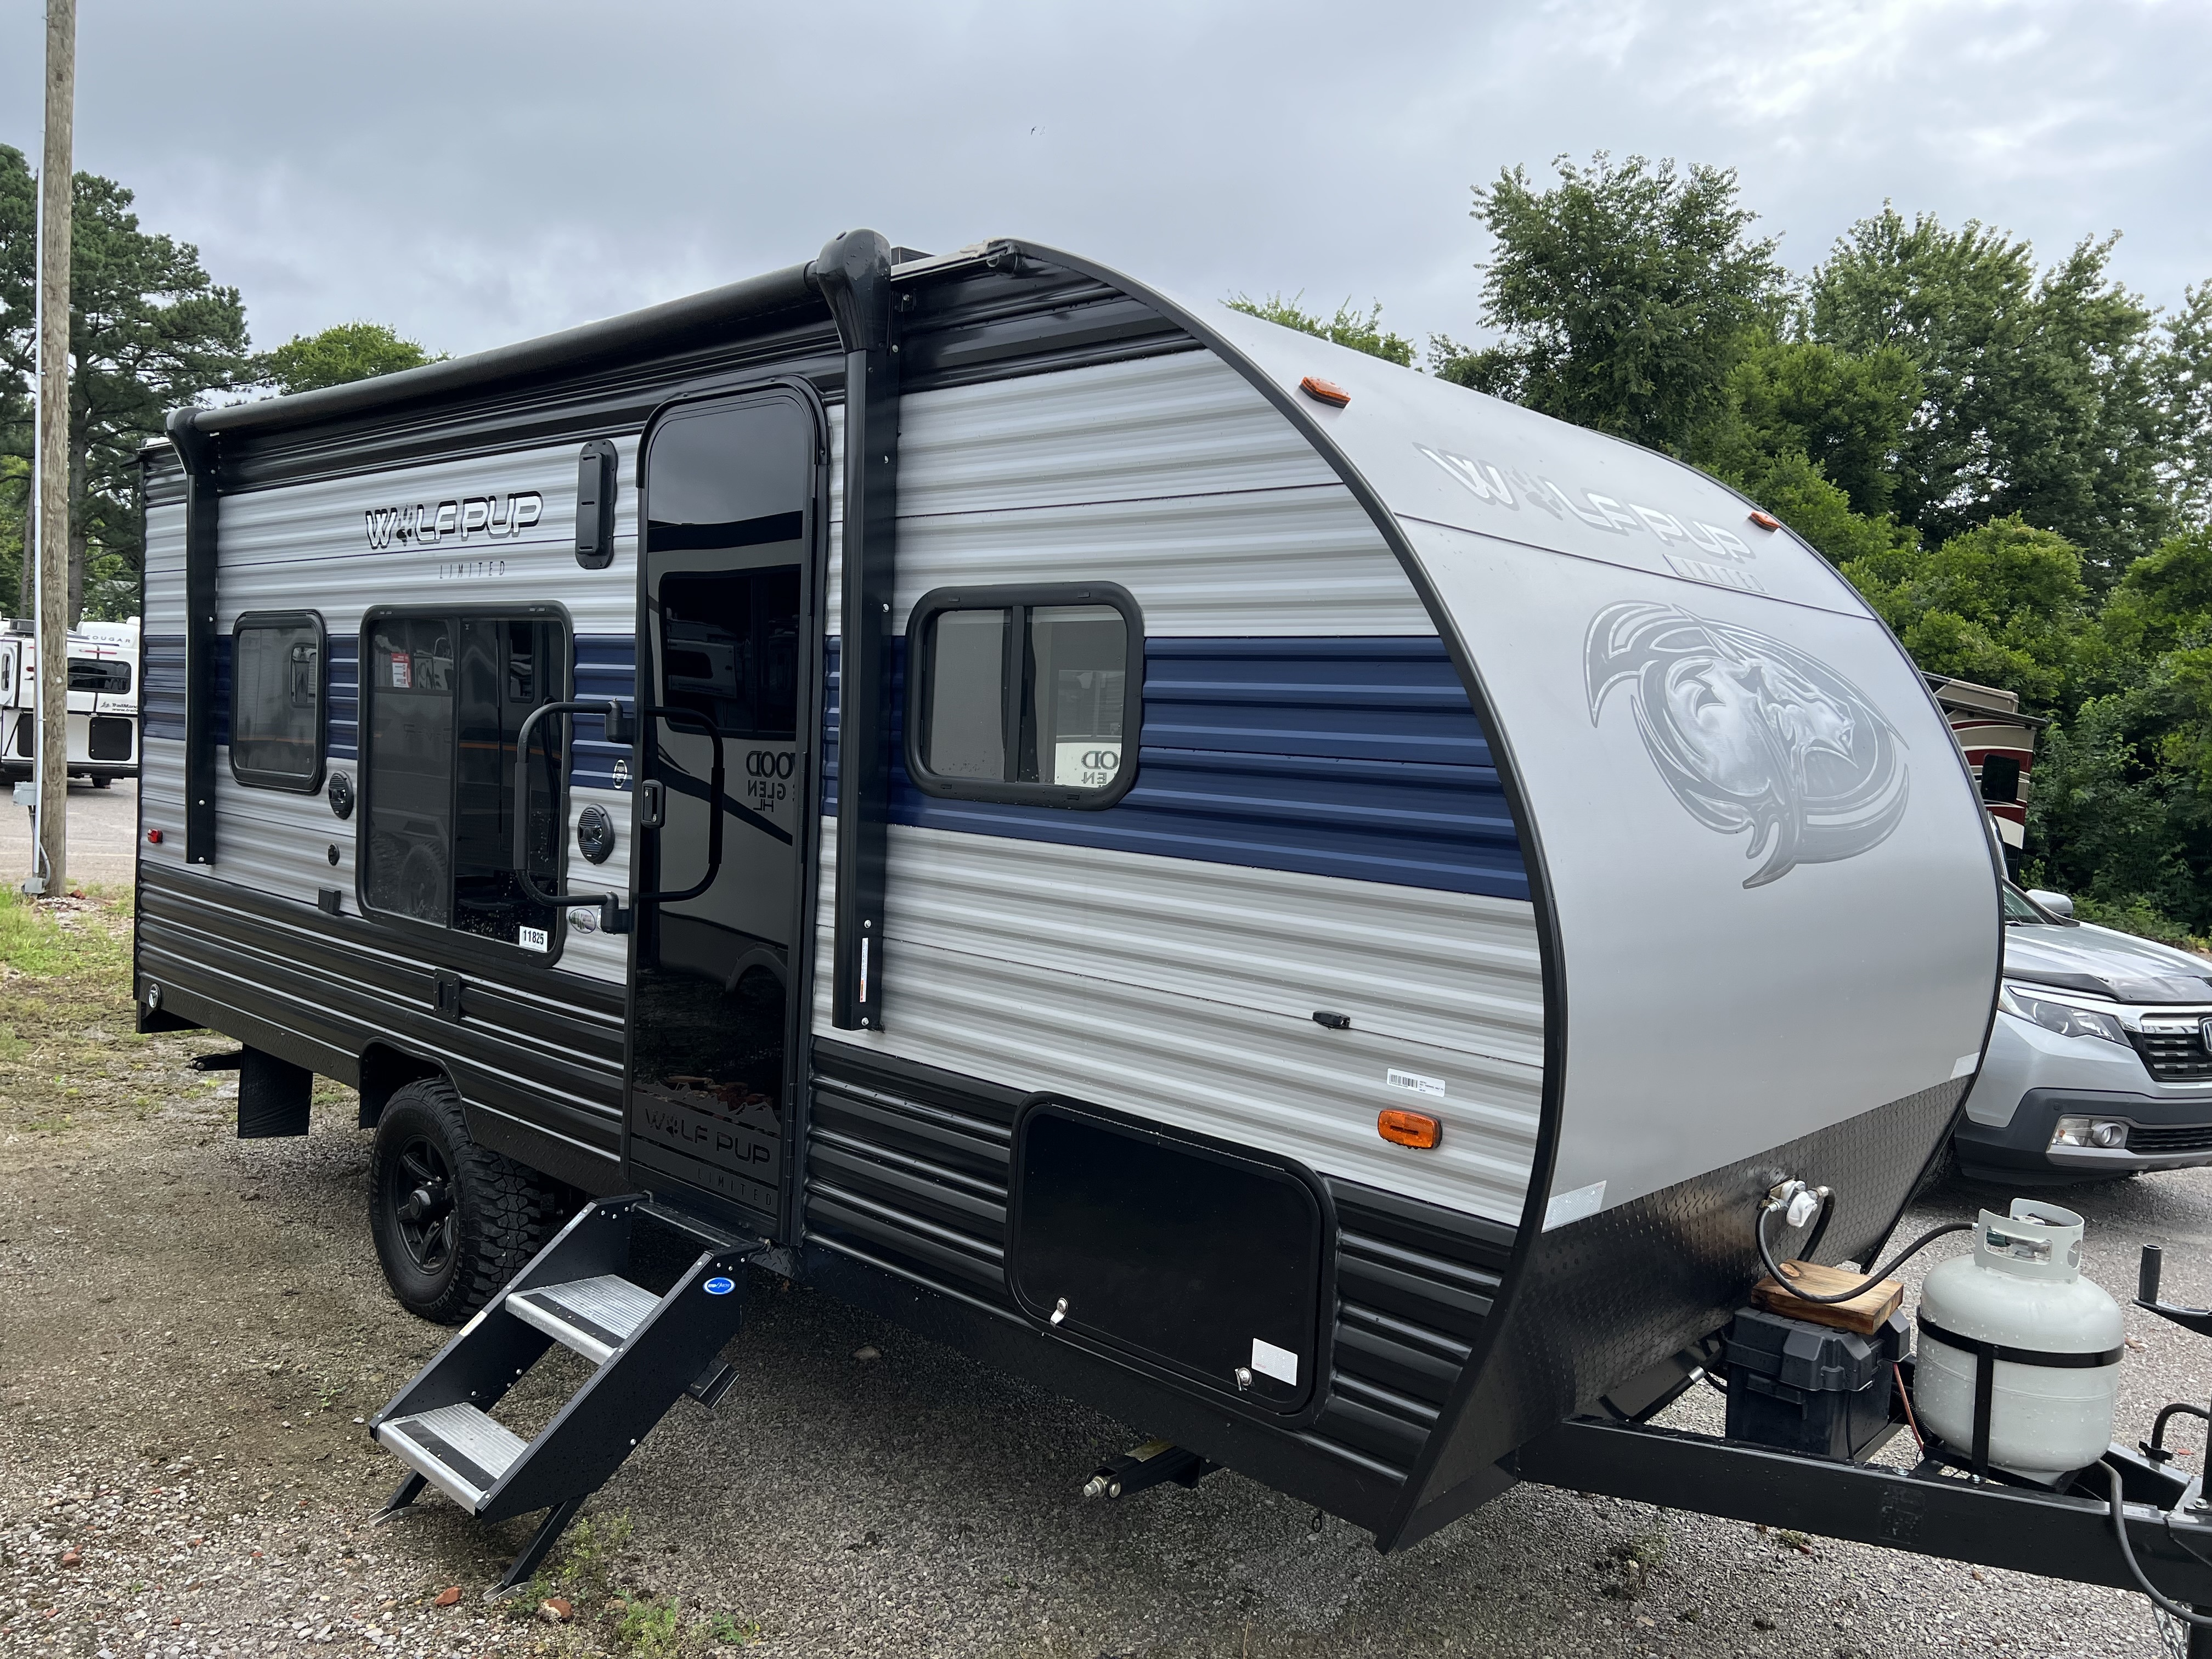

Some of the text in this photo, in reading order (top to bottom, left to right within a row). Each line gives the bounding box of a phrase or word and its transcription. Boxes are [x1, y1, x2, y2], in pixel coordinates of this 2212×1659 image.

[461, 491, 543, 542] PUP
[1621, 498, 1756, 564] PUP
[439, 561, 505, 579] LIMITED
[1664, 555, 1766, 592] LIMITED
[523, 929, 544, 945] 11825
[716, 1131, 770, 1165] PUP
[698, 1167, 771, 1206] LIMITED
